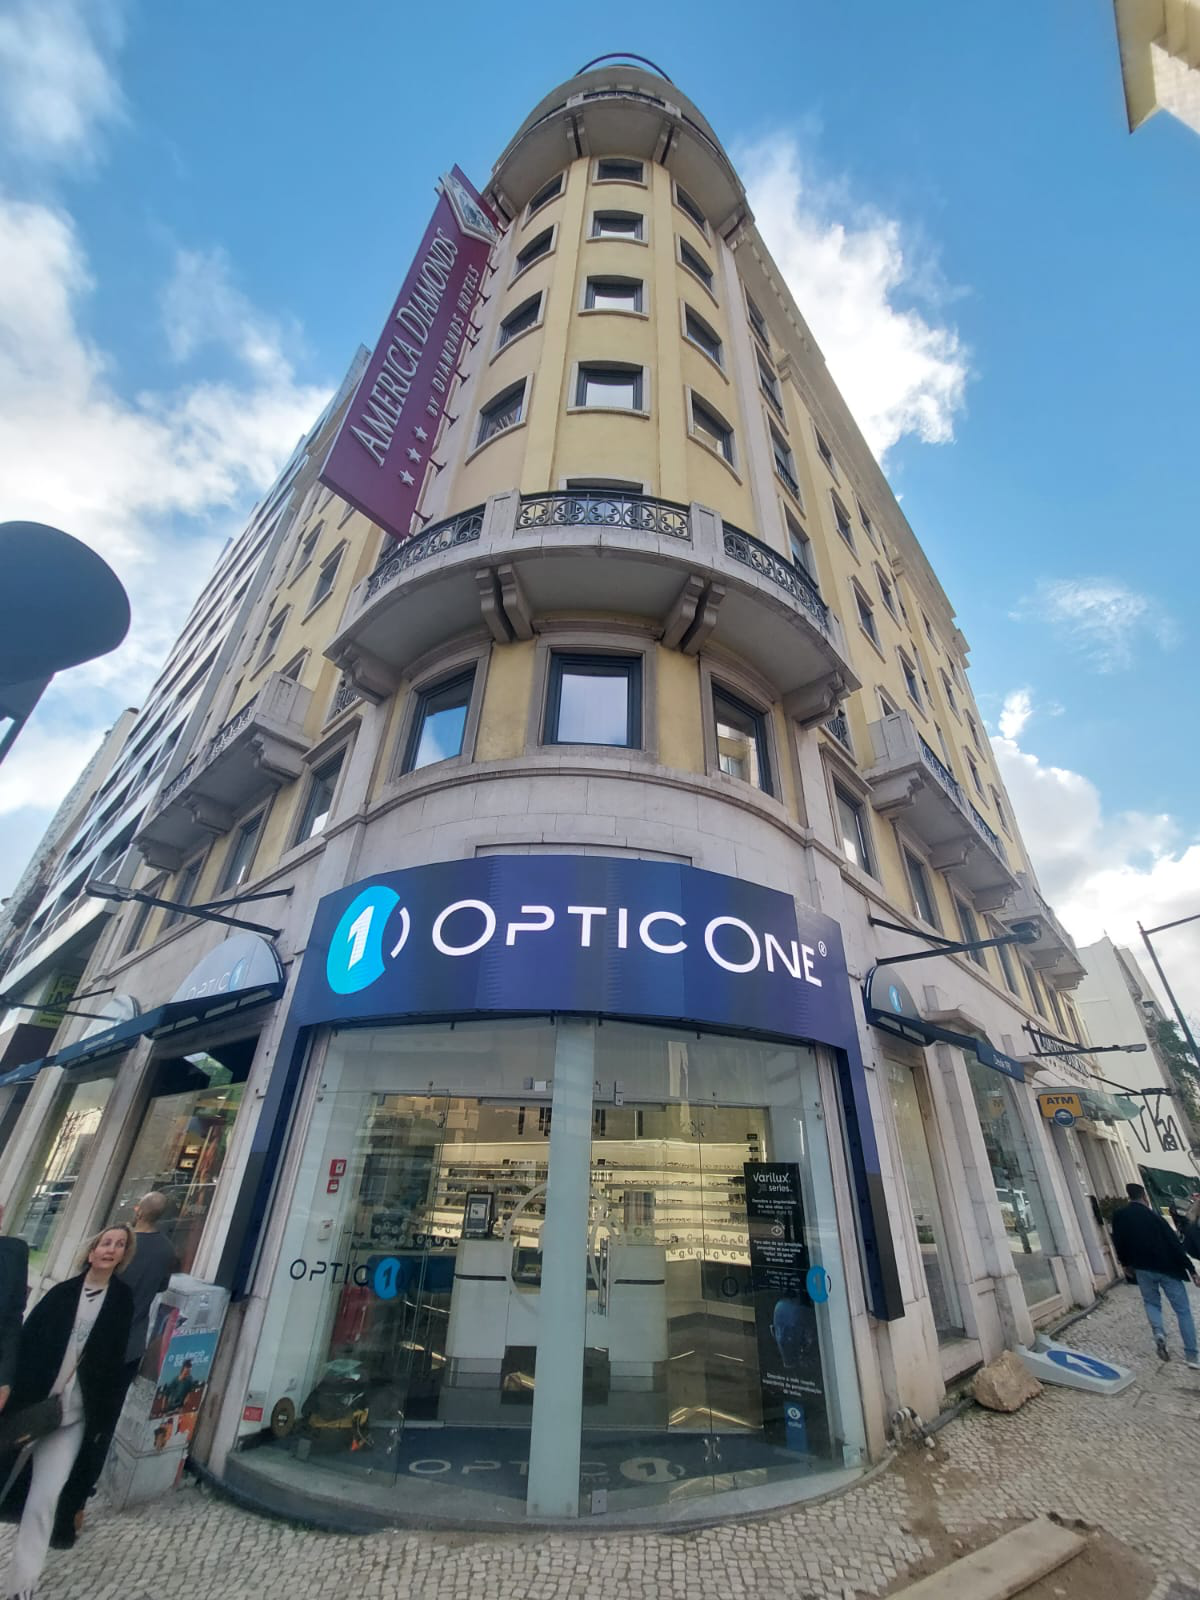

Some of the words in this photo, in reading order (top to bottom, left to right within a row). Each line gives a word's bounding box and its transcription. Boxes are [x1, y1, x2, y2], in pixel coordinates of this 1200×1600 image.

[456, 264, 480, 313] HOTELS
[349, 335, 423, 467] AMERICA
[395, 227, 459, 345] DIAMONDS
[432, 313, 465, 394] DIAMONDS
[426, 396, 441, 418] BY
[1046, 1096, 1074, 1105] ATM
[752, 1171, 790, 1183] Varilux
[289, 1258, 370, 1287] OPTIC
